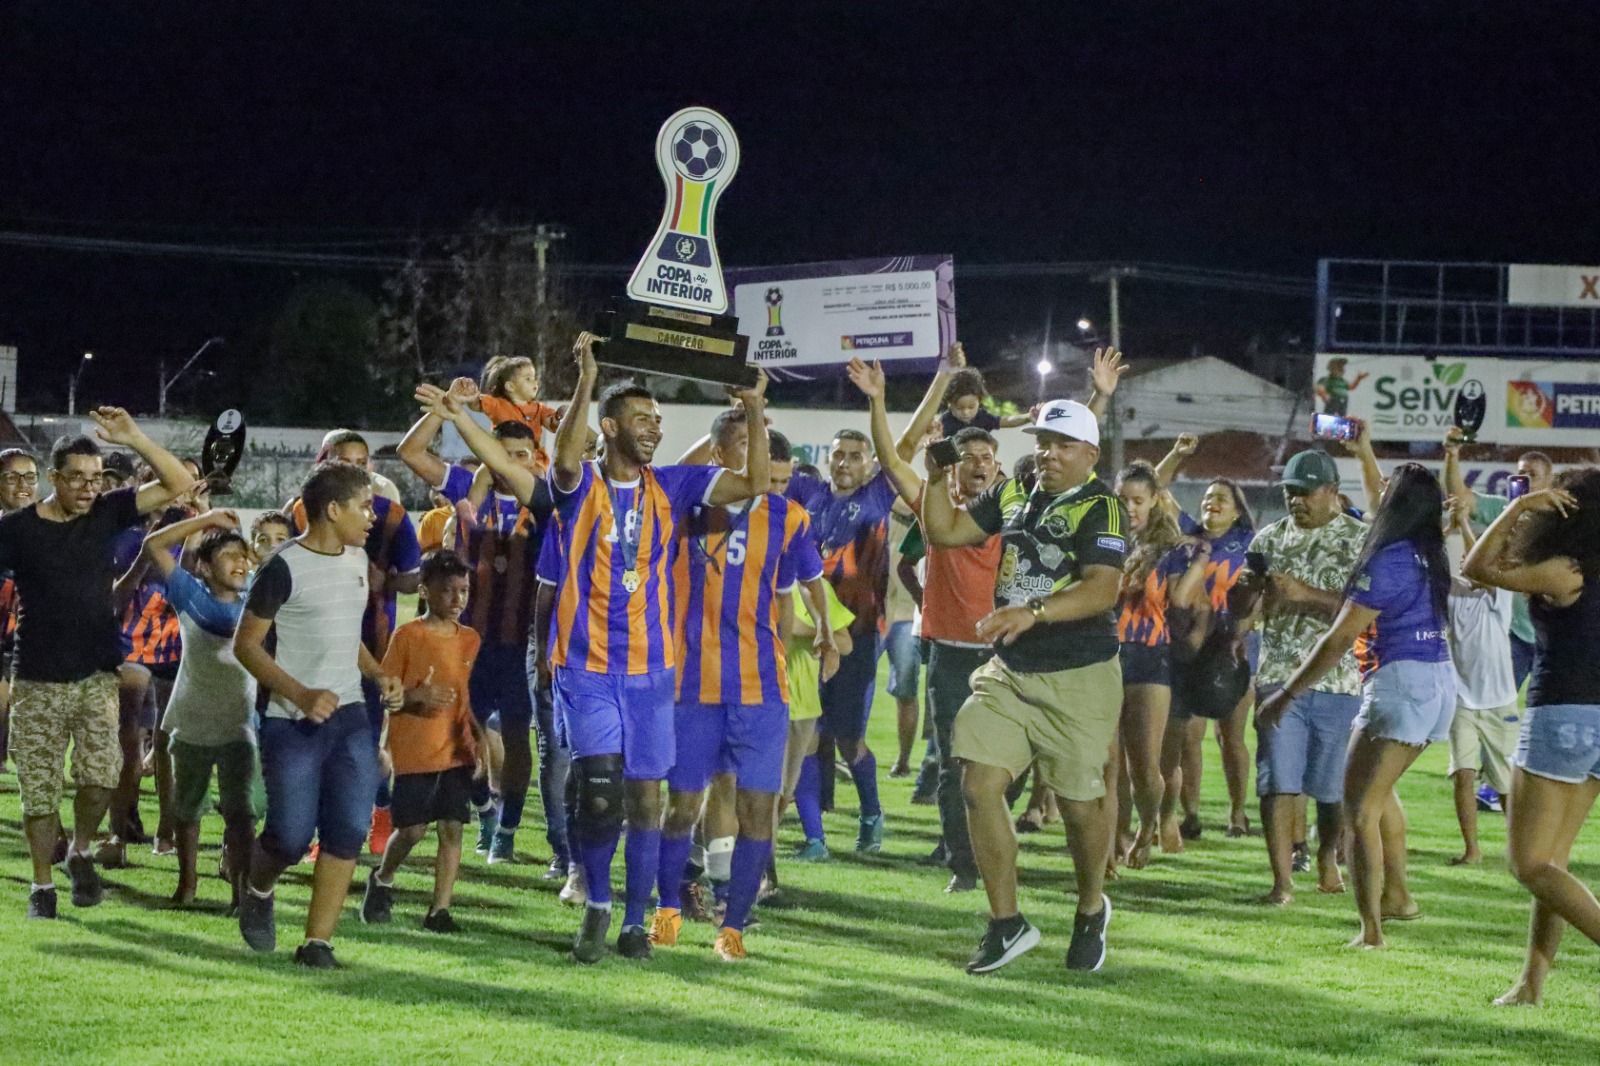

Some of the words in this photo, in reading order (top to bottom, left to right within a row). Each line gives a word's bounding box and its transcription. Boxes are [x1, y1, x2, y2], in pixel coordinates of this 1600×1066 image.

[656, 264, 692, 284] COPA
[646, 277, 713, 303] INTERIOR
[885, 283, 896, 291] R$
[898, 281, 931, 291] 5.000,00
[657, 331, 704, 350] CAMPEÃO
[758, 339, 782, 350] COPA
[753, 348, 798, 360] INTERIOR
[1374, 376, 1456, 412] Seiv
[1557, 393, 1600, 415] PETR
[1403, 413, 1428, 426] DO
[1433, 414, 1455, 426] VA
[605, 508, 637, 543] 18
[726, 530, 747, 566] 5
[1015, 573, 1053, 590] Paulo
